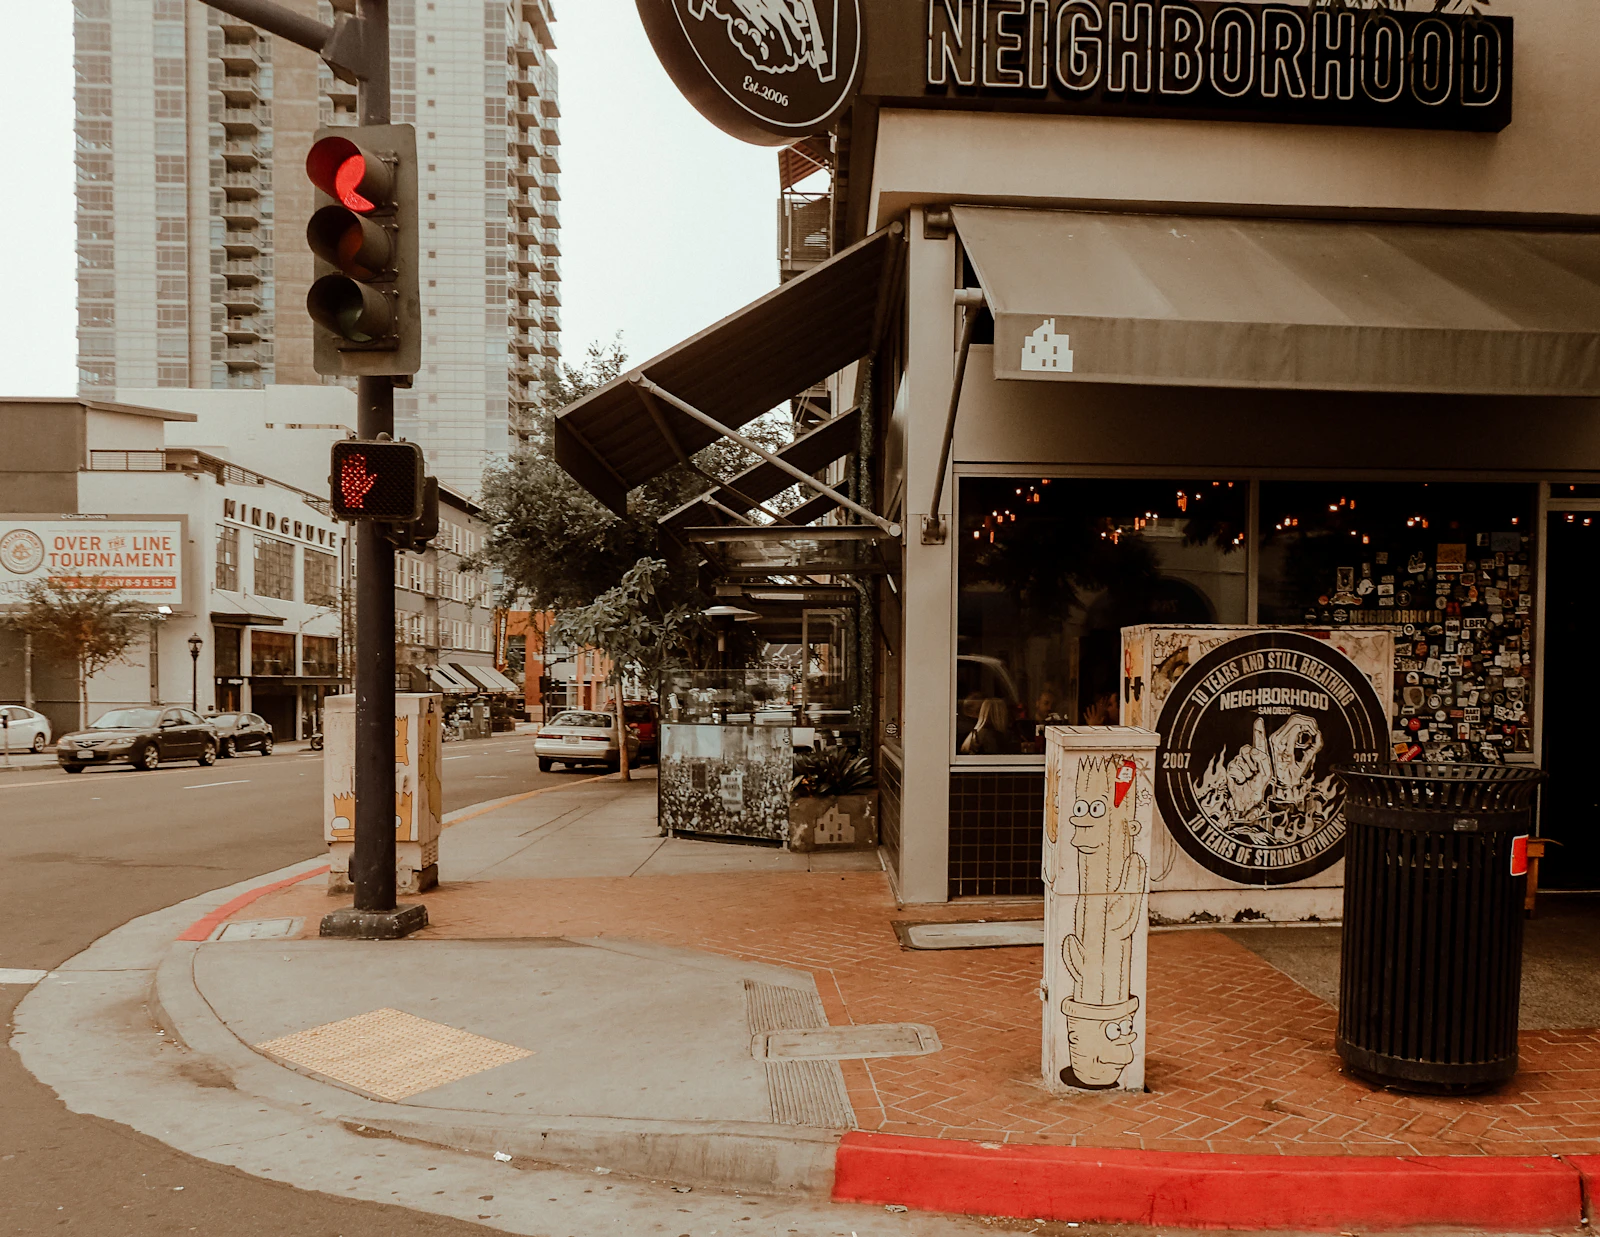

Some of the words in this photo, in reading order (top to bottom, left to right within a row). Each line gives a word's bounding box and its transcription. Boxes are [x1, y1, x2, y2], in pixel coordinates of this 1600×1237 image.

[926, 0, 1501, 107] NEIGHBORHOOD
[742, 75, 789, 107] Est.2006
[223, 498, 337, 548] MINDGRUVE
[54, 536, 101, 551] OVER
[108, 538, 125, 549] THE
[133, 536, 171, 551] LINE
[48, 552, 176, 567] TOURNAMENT
[1350, 610, 1443, 623] NEIGHBORHOOD
[1191, 689, 1209, 706] 10
[1203, 661, 1240, 694] YEARS
[1241, 651, 1265, 674] AND
[1267, 651, 1298, 671] STILL
[1299, 656, 1355, 706] BREATHING
[1219, 687, 1329, 711] NEIGHBORHOOD
[1258, 706, 1272, 715] SAN
[1272, 706, 1291, 715] DIEGO
[1162, 752, 1191, 769] 2007
[1188, 813, 1206, 832] 10
[1200, 825, 1236, 858] YEARS
[1235, 846, 1253, 864] OF
[1254, 846, 1301, 866] STRONG
